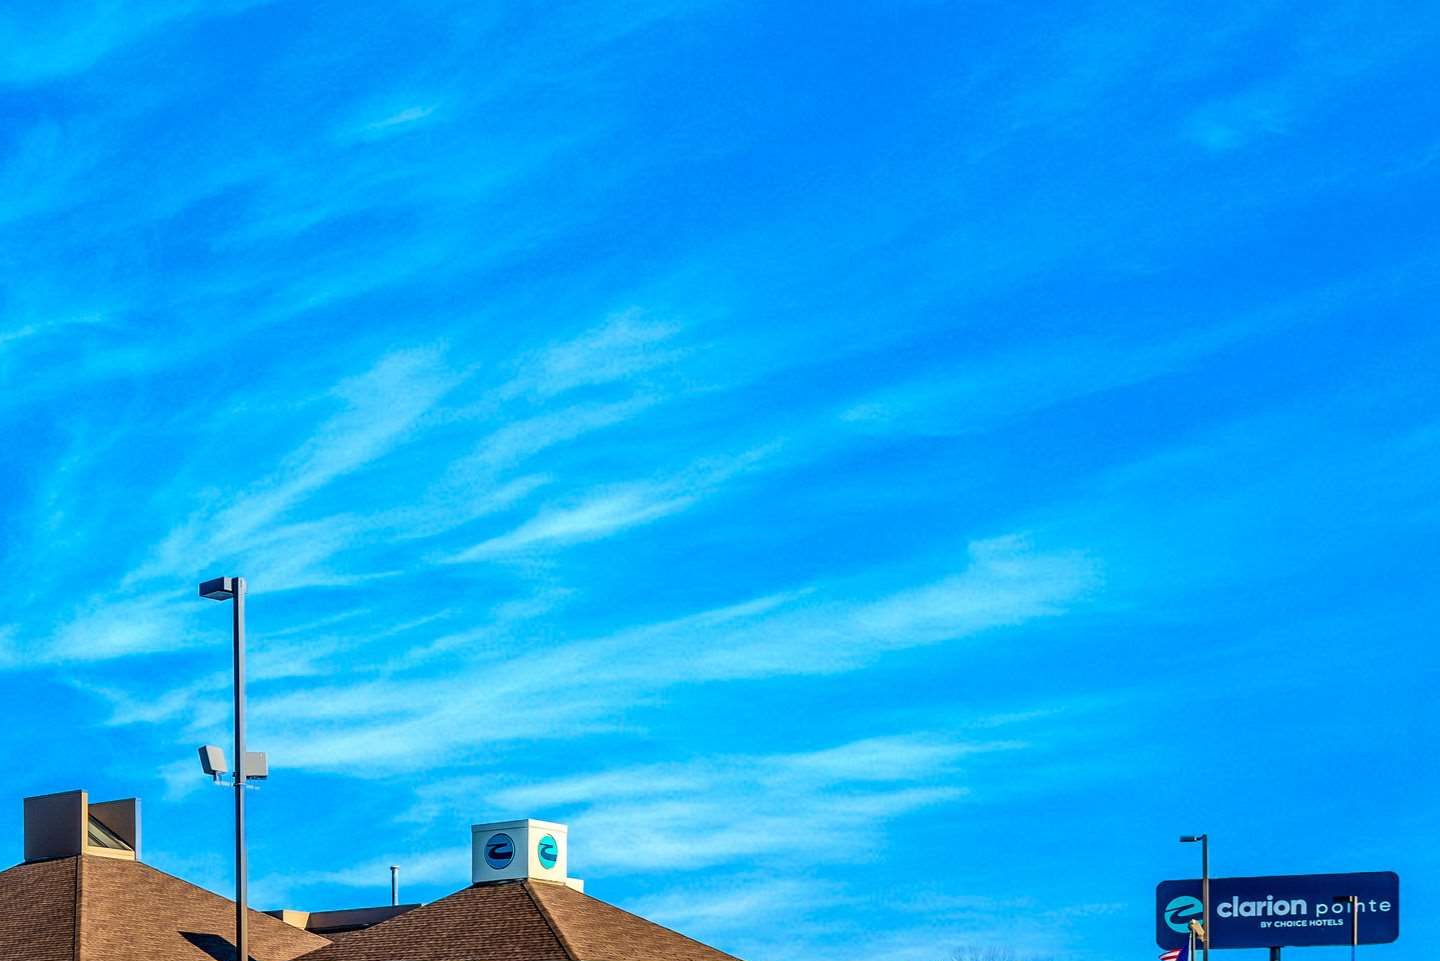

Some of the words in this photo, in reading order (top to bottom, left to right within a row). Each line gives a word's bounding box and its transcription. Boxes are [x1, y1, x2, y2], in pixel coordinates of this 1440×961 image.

[1216, 894, 1307, 918] clarion
[1316, 899, 1392, 918] pointe
[1260, 921, 1272, 929] BY
[1274, 920, 1308, 928] CHOICE
[1309, 918, 1344, 927] HOTELS
